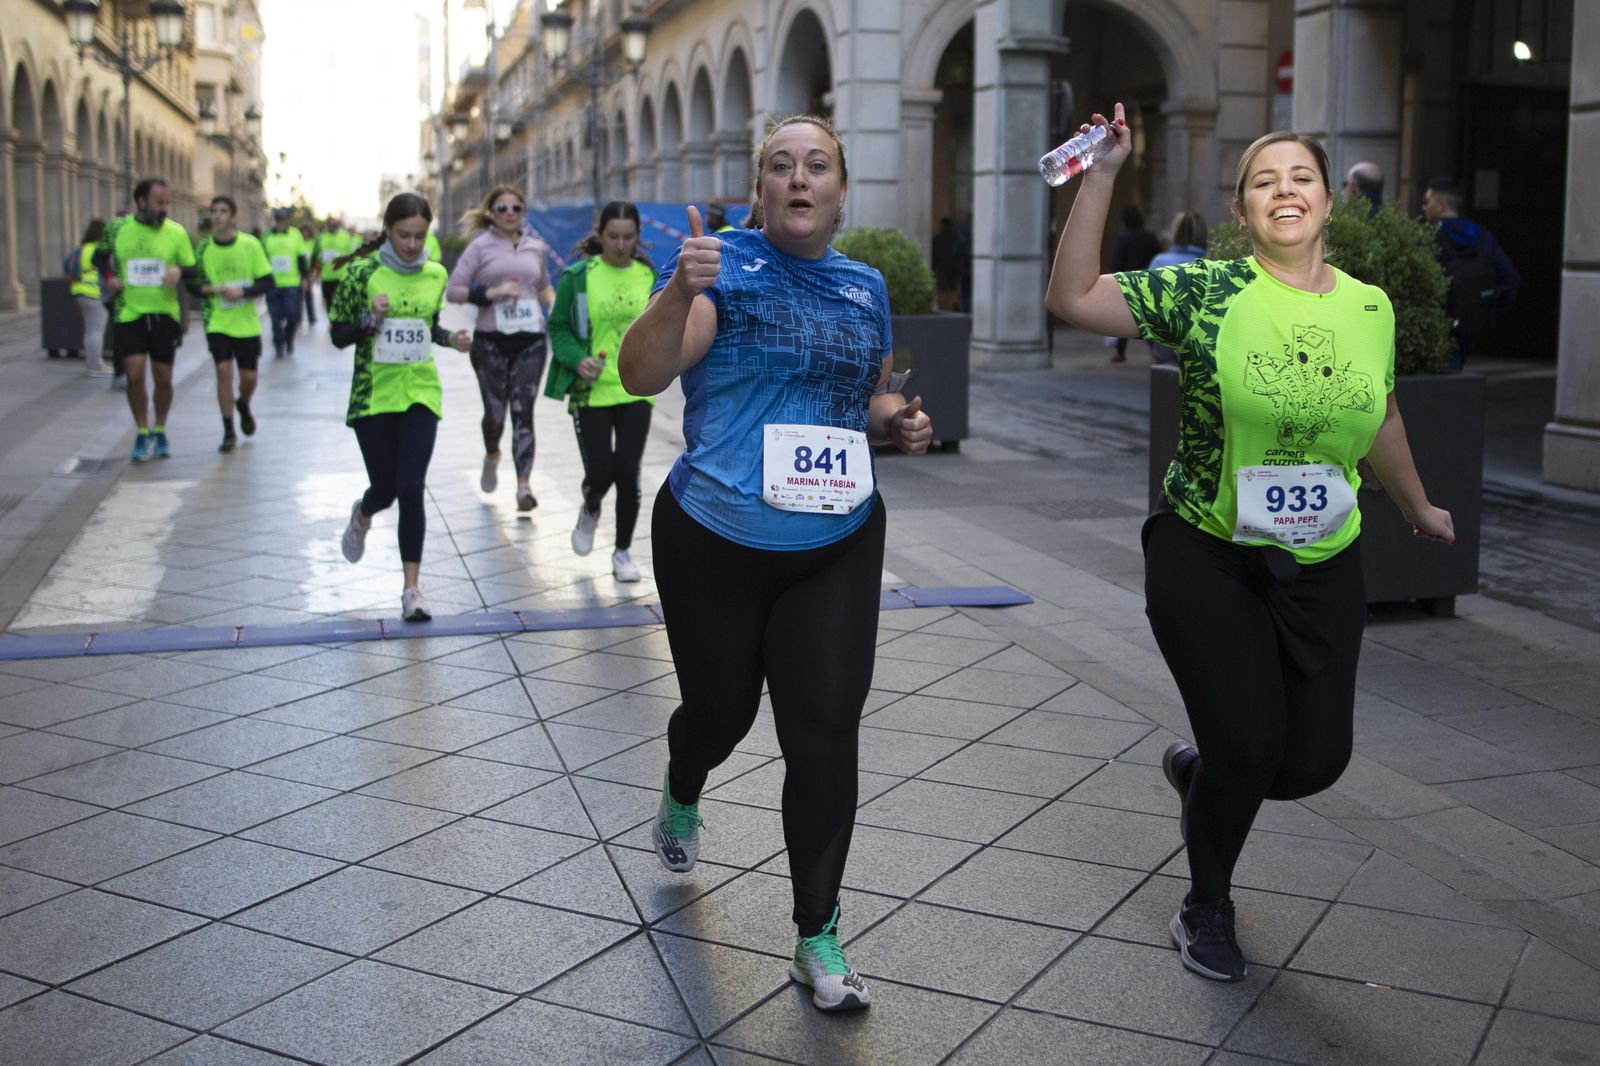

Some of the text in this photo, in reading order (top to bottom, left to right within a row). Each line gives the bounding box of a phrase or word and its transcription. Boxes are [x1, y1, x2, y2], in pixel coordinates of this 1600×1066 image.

[384, 329, 424, 344] 1535
[1265, 448, 1305, 458] carrera
[793, 445, 847, 475] 841
[786, 477, 820, 487] MARINA
[822, 479, 828, 487] Y
[1265, 484, 1328, 513] 933
[1273, 515, 1319, 525] PAPA PEPE
